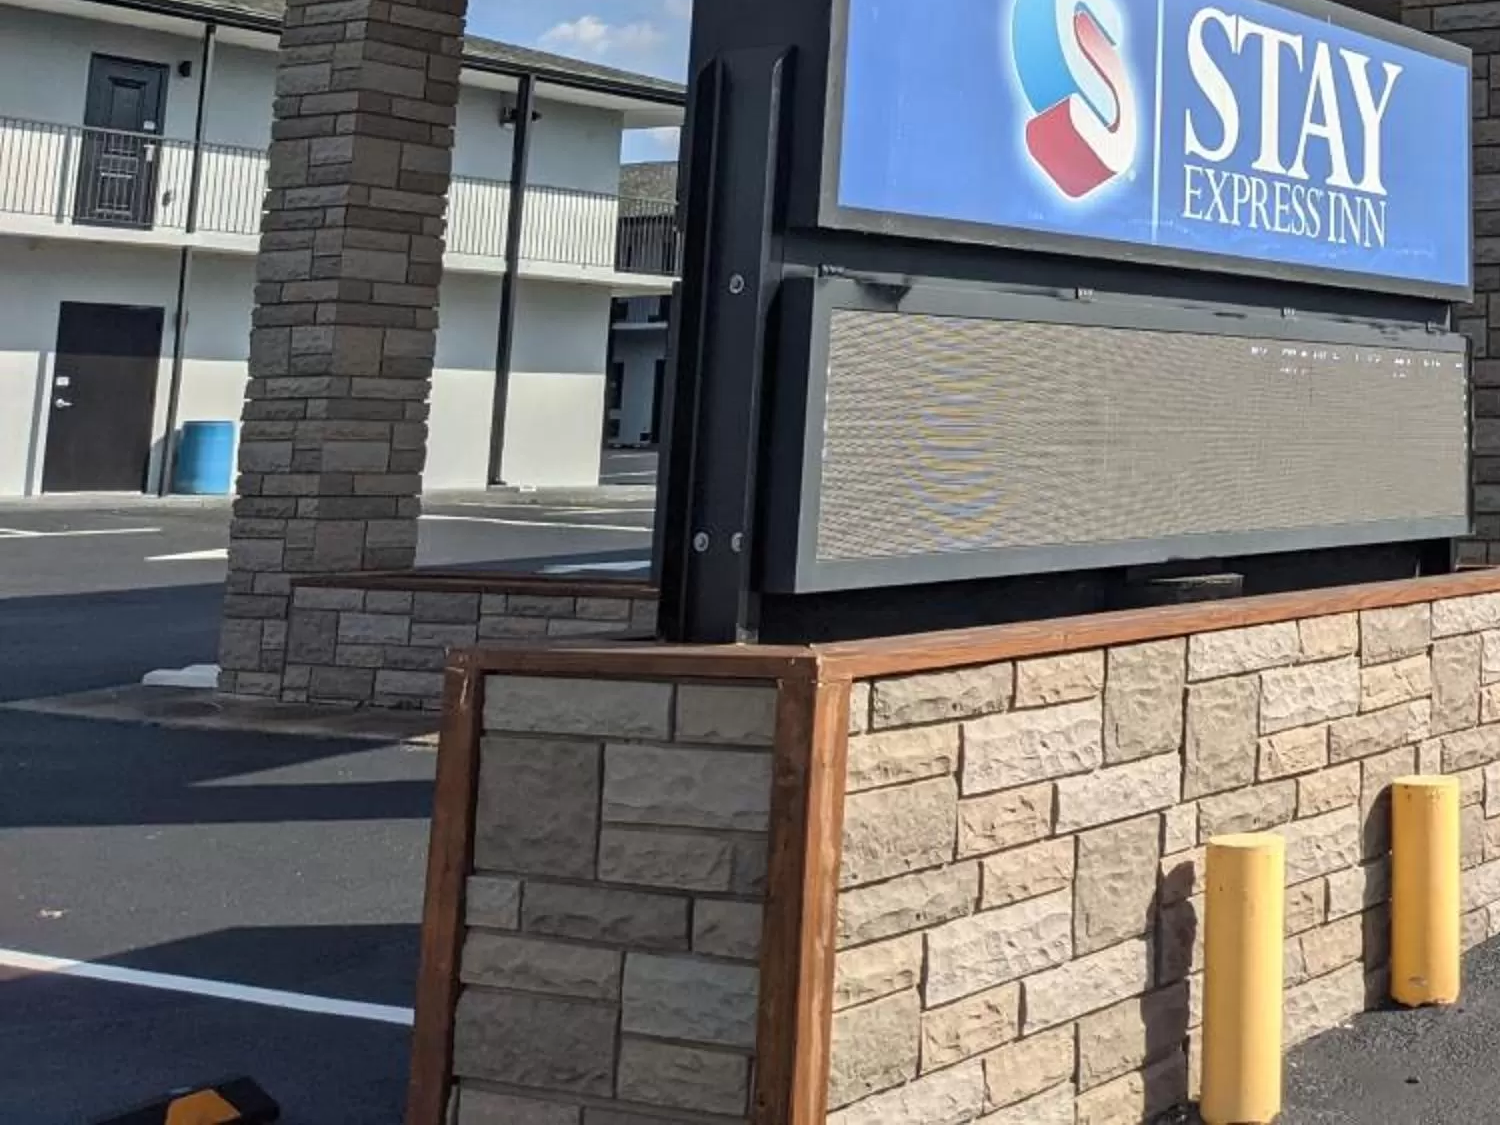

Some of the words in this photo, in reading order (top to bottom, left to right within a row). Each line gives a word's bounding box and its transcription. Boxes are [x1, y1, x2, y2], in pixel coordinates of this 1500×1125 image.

[1184, 6, 1403, 196] STAY
[1181, 164, 1323, 238] EXPRESS
[1326, 190, 1387, 249] INN
